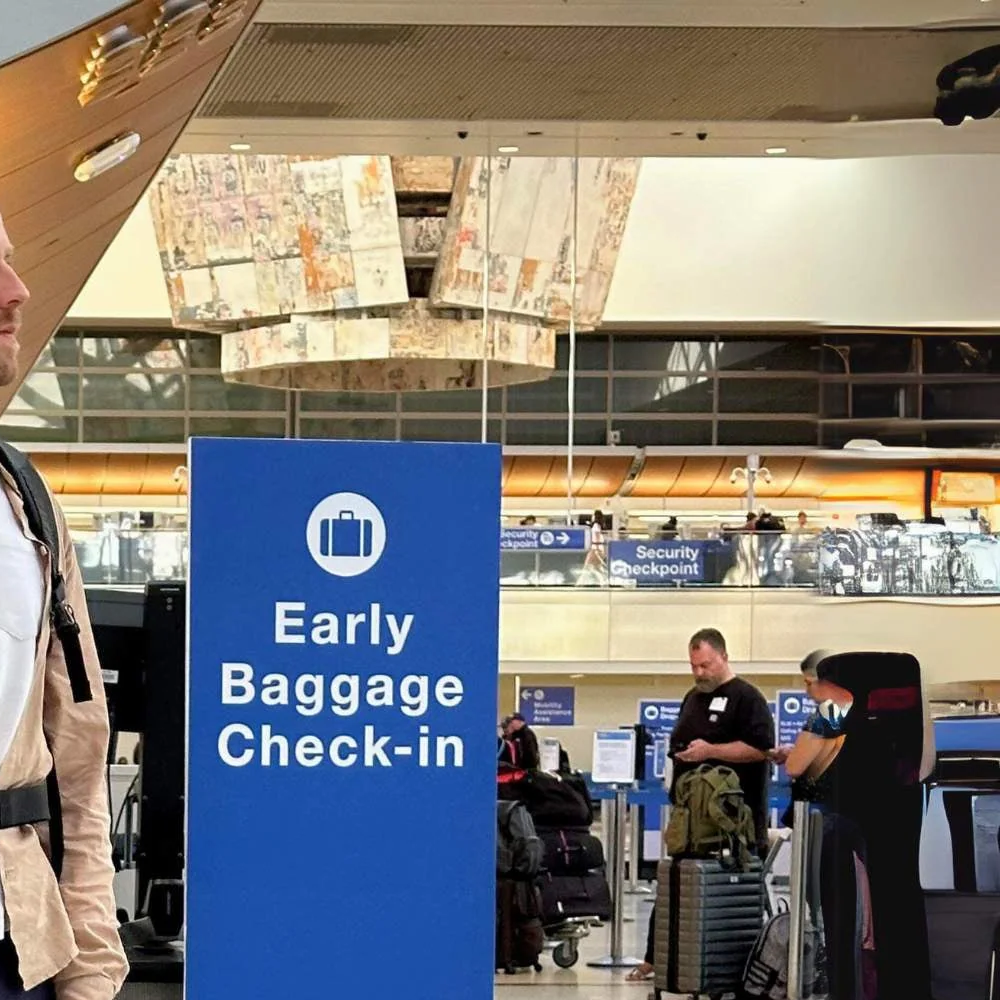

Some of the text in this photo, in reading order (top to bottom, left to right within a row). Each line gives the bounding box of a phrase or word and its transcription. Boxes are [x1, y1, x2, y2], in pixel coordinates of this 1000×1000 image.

[500, 540, 538, 550] ckpoint
[636, 545, 699, 561] Security
[274, 601, 414, 654] Early
[221, 662, 464, 716] Baggage
[217, 723, 464, 768] Check-in
